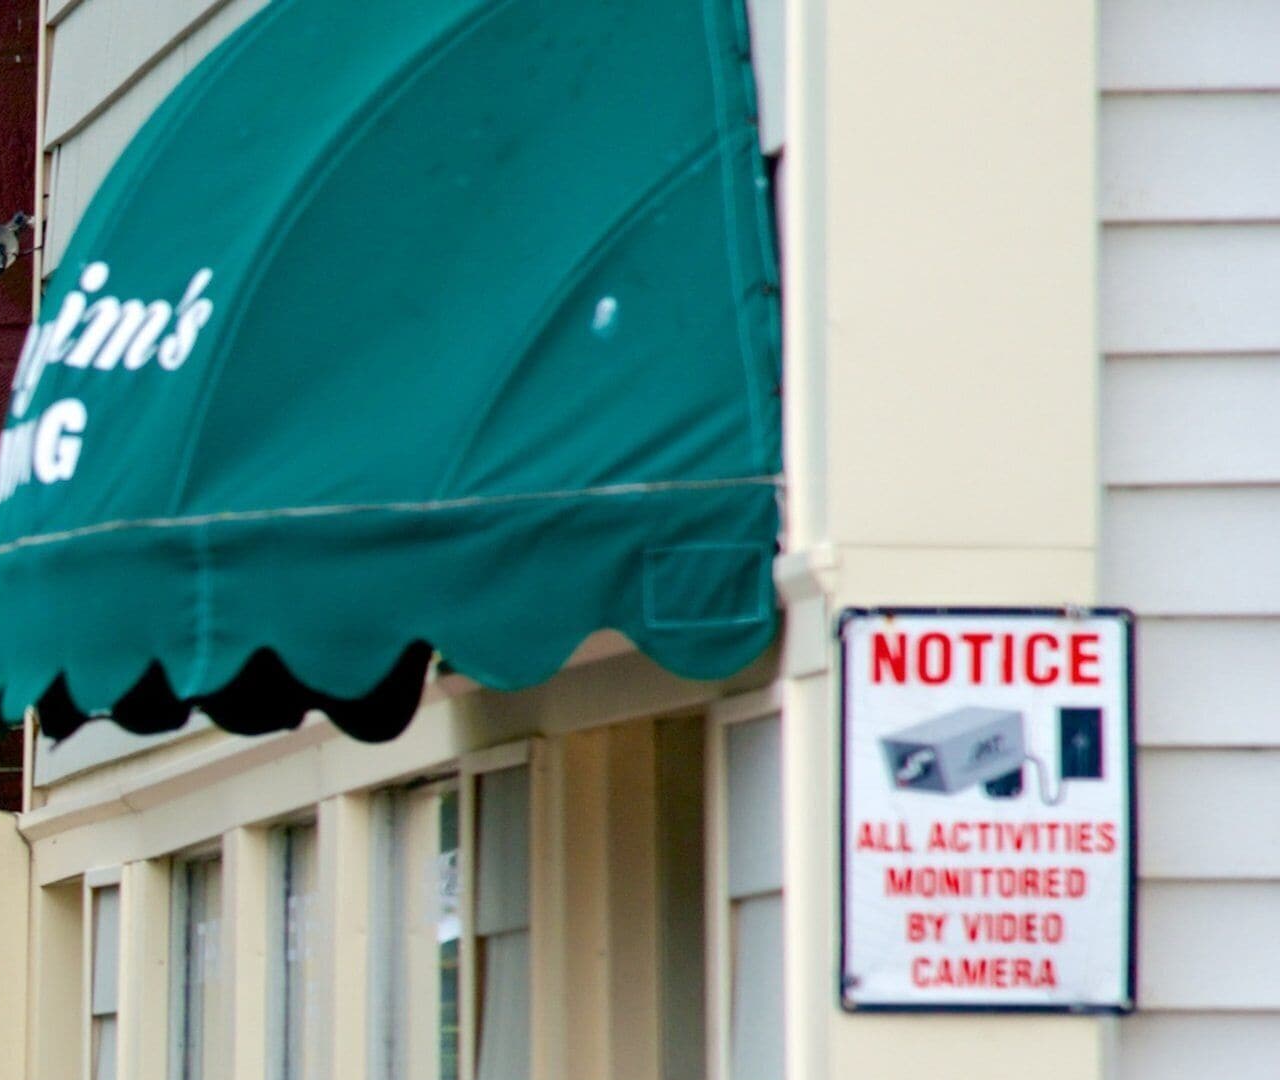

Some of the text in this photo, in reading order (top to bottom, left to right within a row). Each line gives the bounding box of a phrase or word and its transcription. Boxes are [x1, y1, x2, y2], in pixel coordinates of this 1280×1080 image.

[869, 632, 1103, 687] NOTICE
[856, 820, 1117, 855] ALL ACTIVITIES
[883, 866, 1087, 899] MONITORED
[906, 912, 1065, 945] BY VIDEO
[911, 957, 1059, 990] CAMERA
